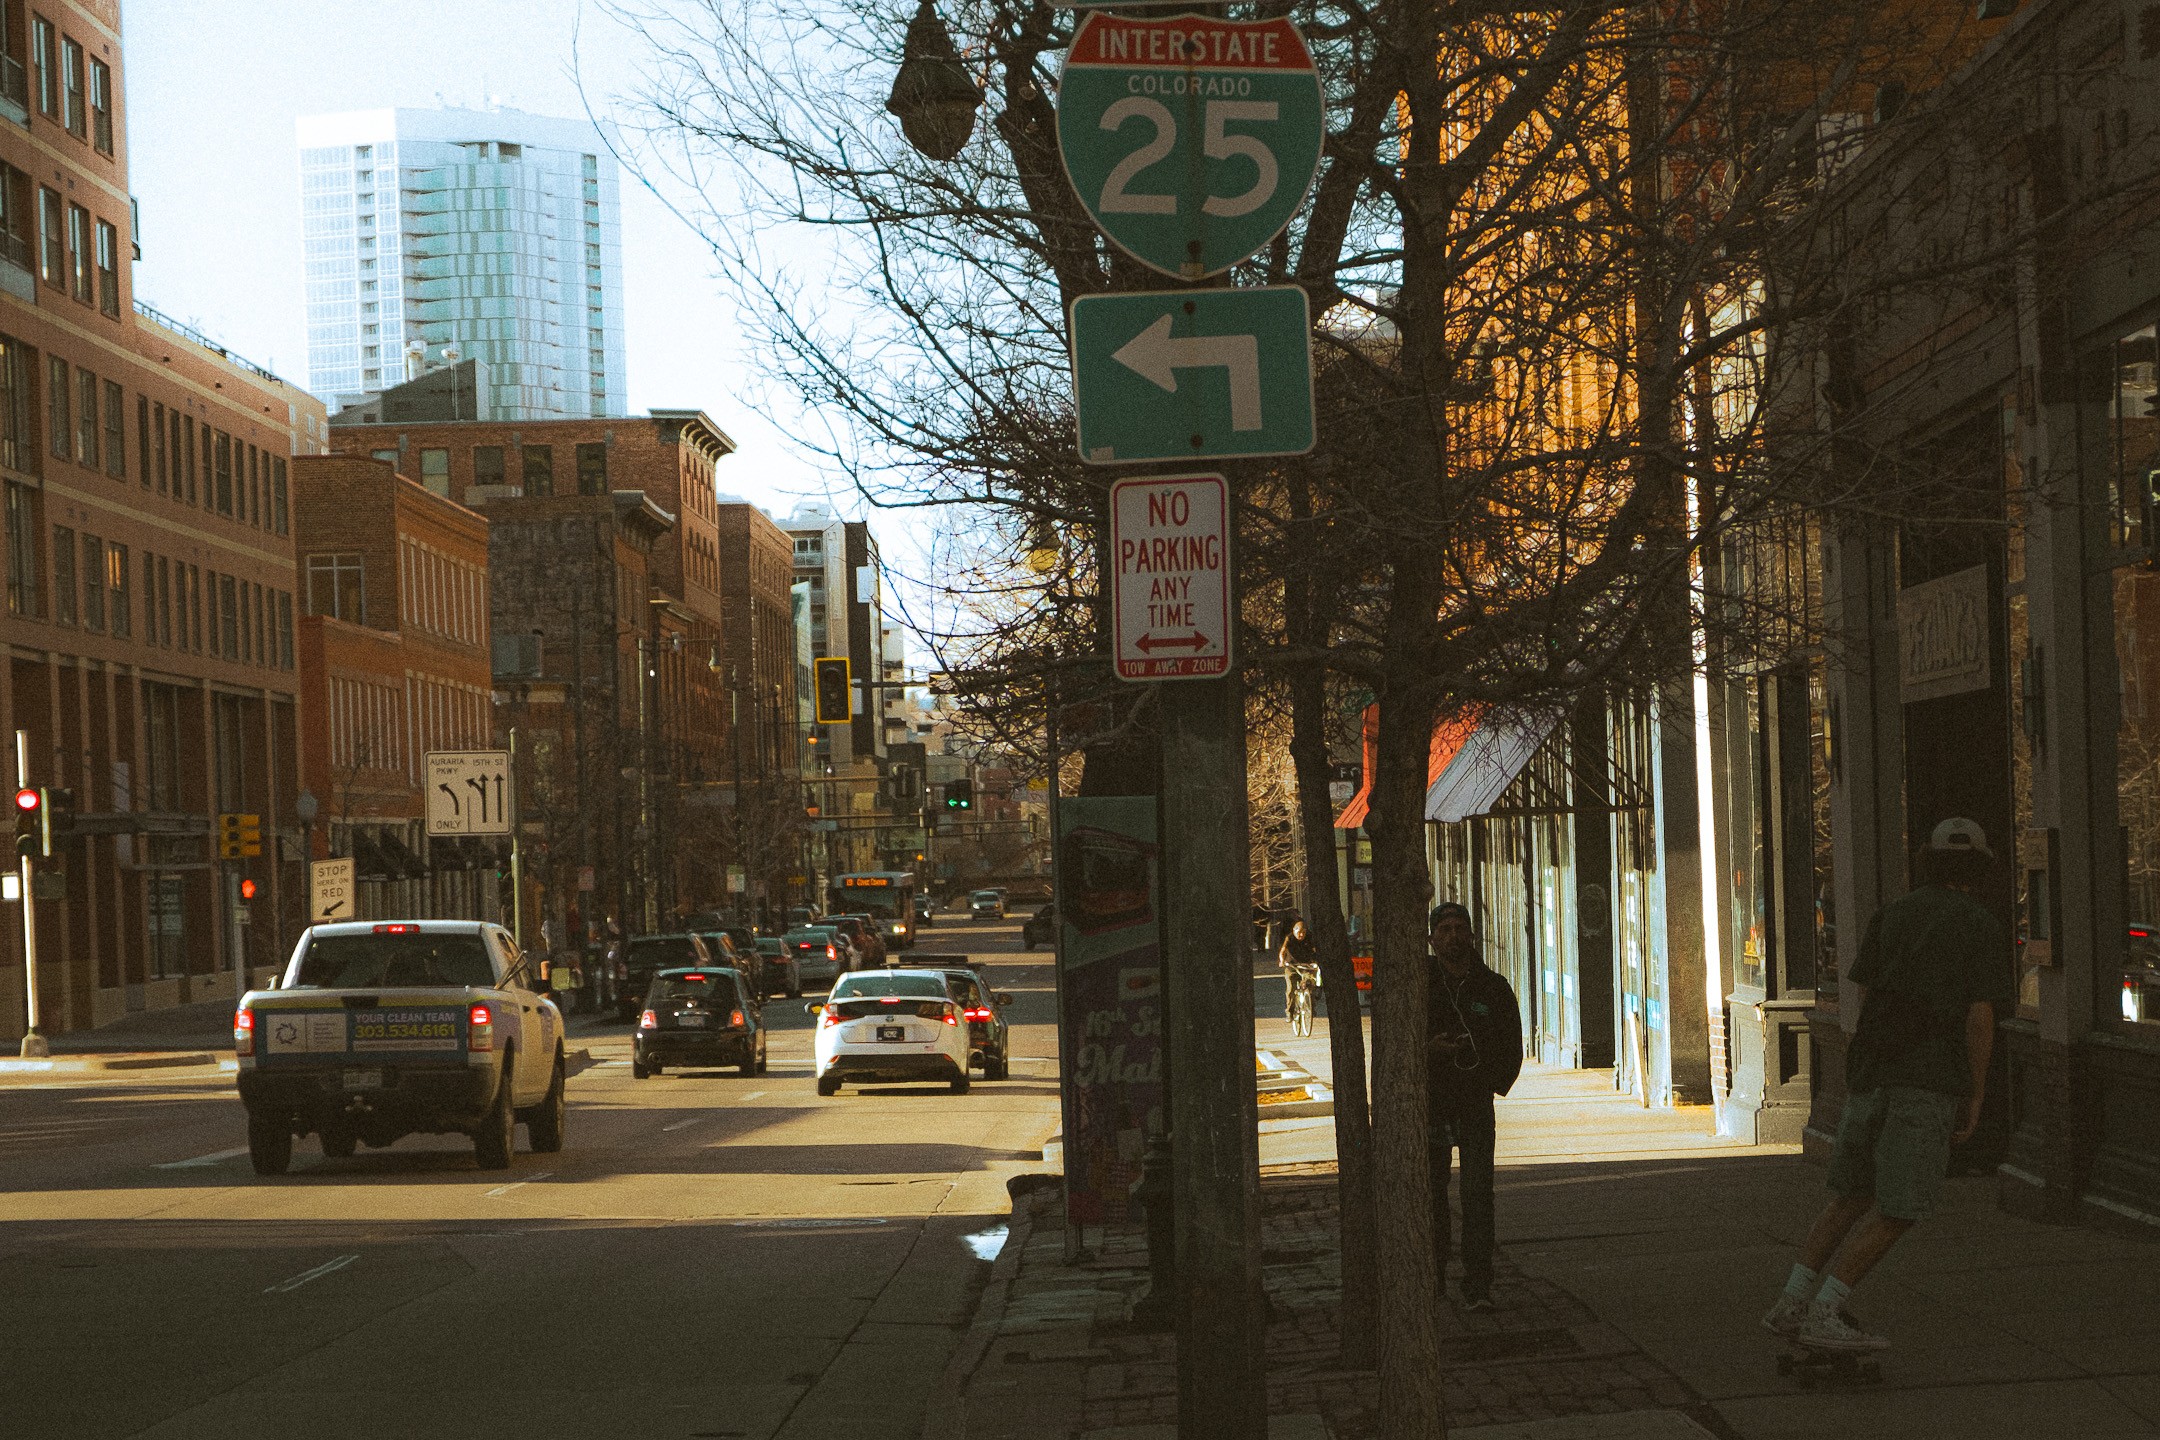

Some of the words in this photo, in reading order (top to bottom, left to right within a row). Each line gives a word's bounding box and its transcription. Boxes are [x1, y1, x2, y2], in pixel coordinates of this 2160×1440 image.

[1100, 27, 1280, 63] INTERSTATE
[1127, 74, 1250, 97] COLORADO
[1099, 96, 1279, 217] 25
[1149, 490, 1190, 527] NO
[1121, 534, 1219, 574] PARKING
[1150, 576, 1192, 601] ANY
[1147, 602, 1195, 627] TIME
[1124, 661, 1146, 675] TOW
[1155, 659, 1184, 674] AWAY
[1193, 658, 1221, 672] ZONE
[430, 758, 465, 766] AURARIA
[472, 758, 491, 767] 15TH
[494, 758, 504, 766] ST
[436, 767, 459, 775] PKWY
[435, 820, 461, 829] ONLY
[318, 865, 347, 877] STOP
[338, 877, 348, 885] ON
[321, 887, 344, 898] RED
[355, 1013, 385, 1023] YOUR
[387, 1012, 422, 1023] CLEAN
[425, 1012, 455, 1022] TEAM
[354, 1024, 456, 1038] 303.534.6161
